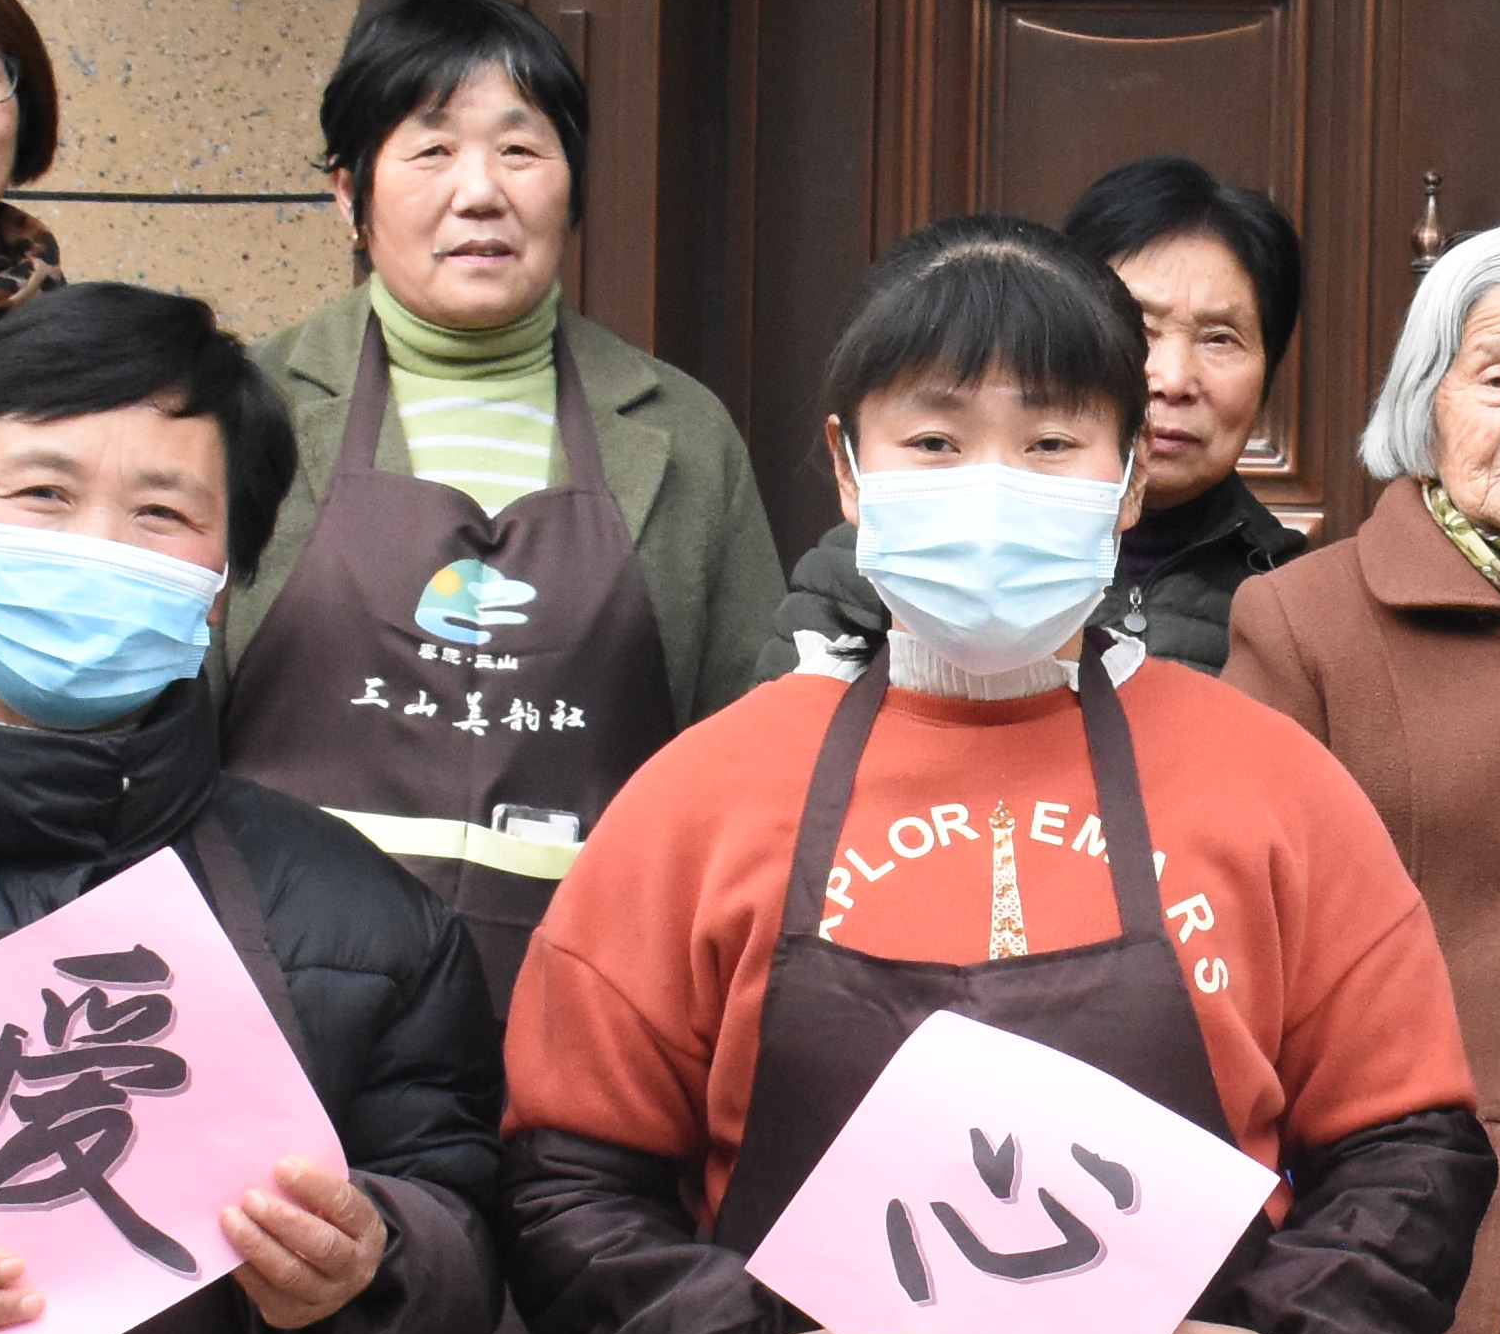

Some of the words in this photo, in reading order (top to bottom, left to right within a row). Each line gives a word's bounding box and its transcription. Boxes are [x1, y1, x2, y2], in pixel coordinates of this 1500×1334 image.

[350, 677, 586, 736] 三山美韵社
[885, 1127, 1142, 1307] 心
